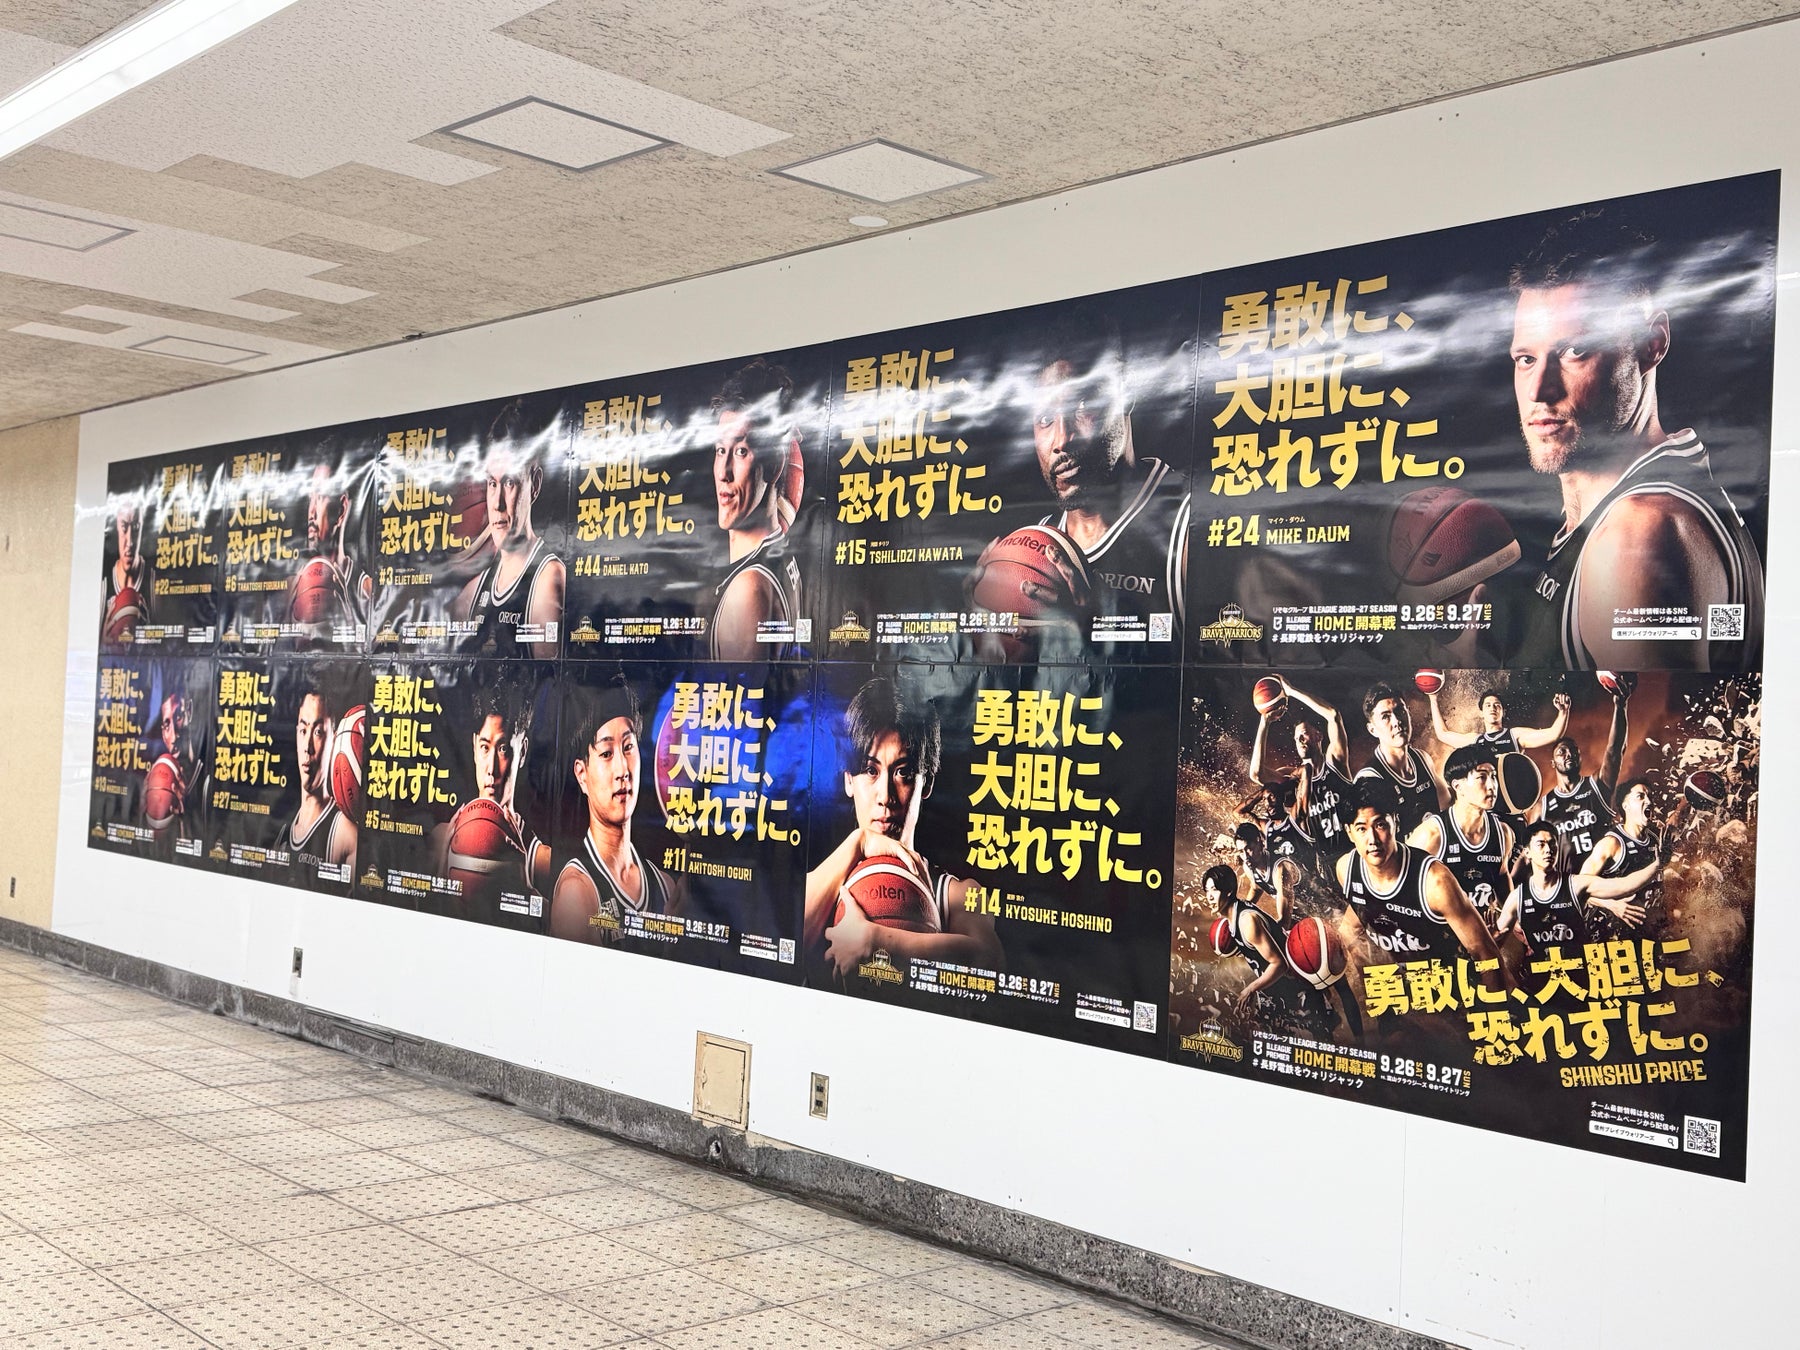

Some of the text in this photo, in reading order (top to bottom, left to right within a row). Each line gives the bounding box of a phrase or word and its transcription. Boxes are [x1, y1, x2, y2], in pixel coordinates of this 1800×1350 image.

[1218, 275, 1415, 360] 勇敢に、
[1212, 352, 1411, 429] 大胆に、
[840, 411, 968, 468] 大胆に、
[1209, 416, 1465, 497] 恐れずに。
[837, 462, 1002, 524] 恐れずに。
[576, 491, 695, 541] 恐れずに。
[380, 512, 471, 555] 恐れずに。
[1207, 515, 1260, 547] #24
[1265, 525, 1350, 545] MIKE DAUM
[156, 534, 219, 570] 恐れずに。
[226, 528, 299, 565] 恐れずに。
[835, 539, 866, 565] #15
[869, 546, 963, 564] TSHILIDZI KAWATA
[379, 567, 394, 586] #3
[575, 554, 600, 577] #44
[603, 563, 649, 576] DANIEL KATO
[155, 579, 169, 595] #22
[225, 575, 237, 592] #6
[960, 613, 1013, 626] 9.26 9.27
[1314, 615, 1396, 631] HOME 開幕戦
[1369, 604, 1398, 613] SEASON
[1400, 603, 1492, 622] 9.26 SAT 9.27 SUN
[904, 622, 930, 634] HOME
[1202, 628, 1262, 641] BRAVE WARRIORS
[100, 668, 144, 700] 勇敢に、
[219, 671, 276, 707] 勇敢に、
[372, 675, 443, 716] 勇敢に、
[98, 702, 142, 735] 大胆に、
[671, 682, 777, 733] 勇敢に、
[972, 689, 1123, 751] 勇敢に、
[216, 710, 273, 745] 大胆に、
[370, 718, 440, 760] 大胆に、
[96, 737, 151, 772] 恐れずに。
[214, 747, 287, 788] 恐れずに。
[668, 733, 774, 787] 大胆に、
[367, 760, 457, 807] 恐れずに。
[968, 750, 1121, 817] 大胆に、
[213, 791, 230, 809] #27
[365, 810, 380, 829] #5
[395, 822, 423, 836] TSUCHIYA
[665, 785, 801, 846] 恐れずに。
[966, 812, 1162, 889] 恐れずに。
[1572, 832, 1593, 855] 15
[663, 848, 686, 872] #11
[688, 861, 753, 881] AKITOSHI OGURI
[964, 886, 1001, 917] #14
[1386, 903, 1422, 918] ORION
[644, 919, 664, 932] HOME
[685, 920, 725, 937] 9.26 9.27
[1005, 903, 1113, 934] KYOSUKE HOSHINO
[939, 971, 996, 993] HOME 開幕戦
[999, 973, 1022, 991] 9.26
[1029, 979, 1054, 997] 9.27
[1466, 998, 1709, 1066] 恐れずに。
[1182, 1038, 1242, 1060] BRAVE WARRIORS
[1266, 1042, 1292, 1054] B.LEAGUE
[1266, 1051, 1290, 1061] PREMIER
[1289, 1037, 1318, 1048] B.LEAGUE
[1318, 1042, 1348, 1055] 2026-27
[1349, 1048, 1377, 1060] SEASON
[1260, 1059, 1364, 1088] 長野電鉄をウォリジャック
[1294, 1048, 1376, 1078] HOME 開幕戦
[1380, 1055, 1471, 1089] 9.26 SAT 9.27 SUN
[1560, 1063, 1642, 1088] SHINSHU
